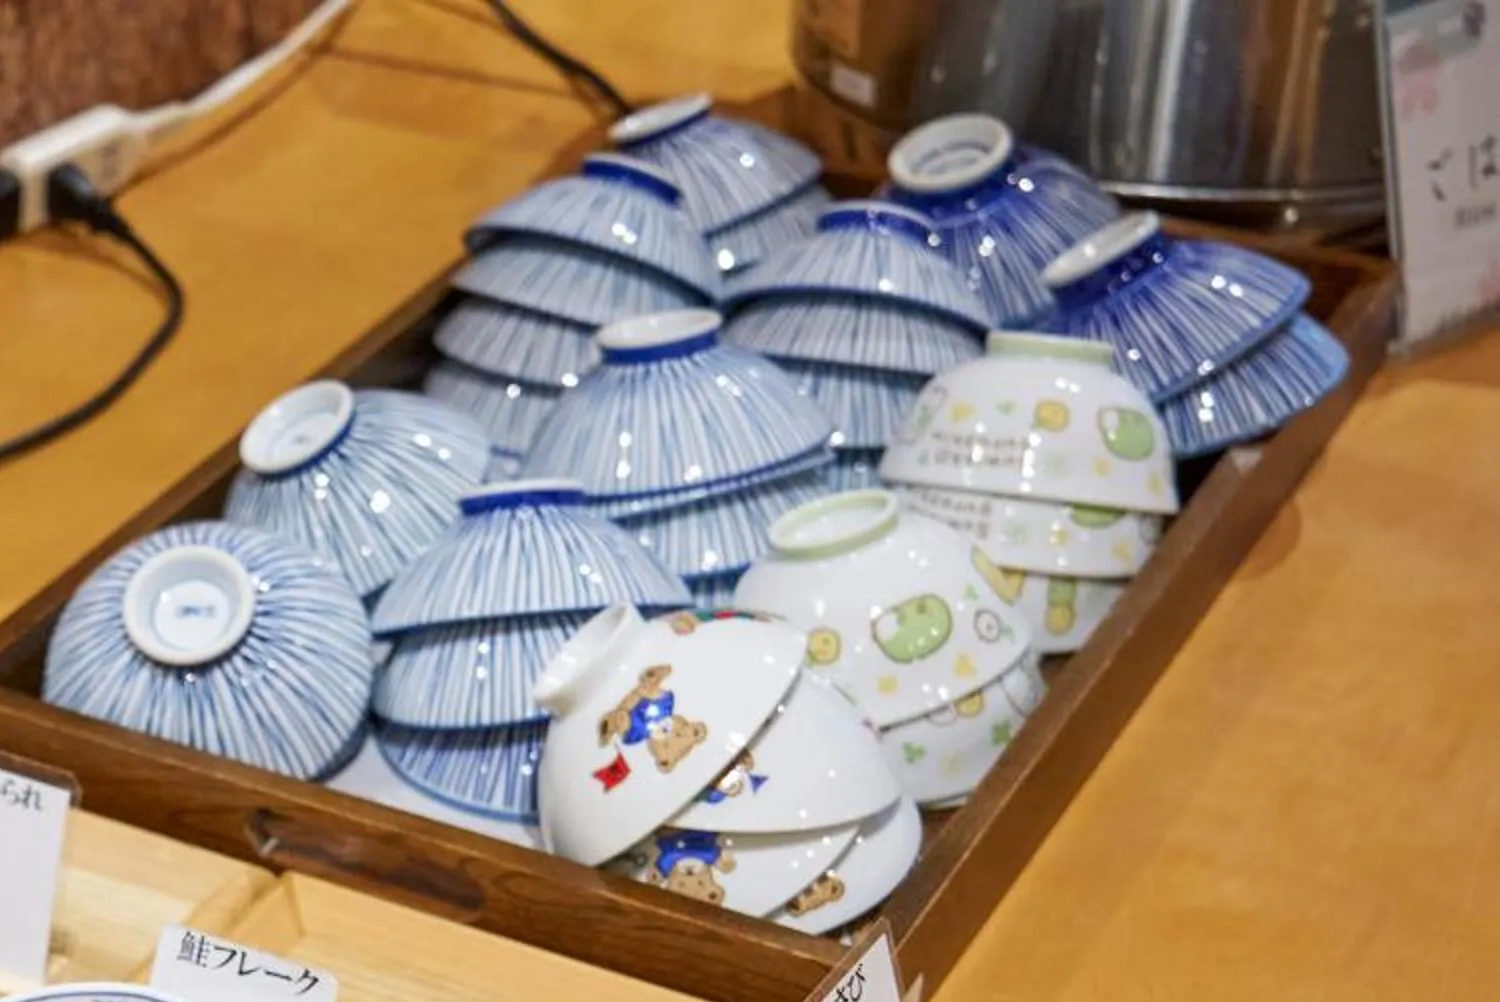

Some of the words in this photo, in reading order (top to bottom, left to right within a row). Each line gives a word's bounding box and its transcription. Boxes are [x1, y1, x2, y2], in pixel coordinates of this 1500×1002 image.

[176, 931, 319, 996] 鮭フレーク
